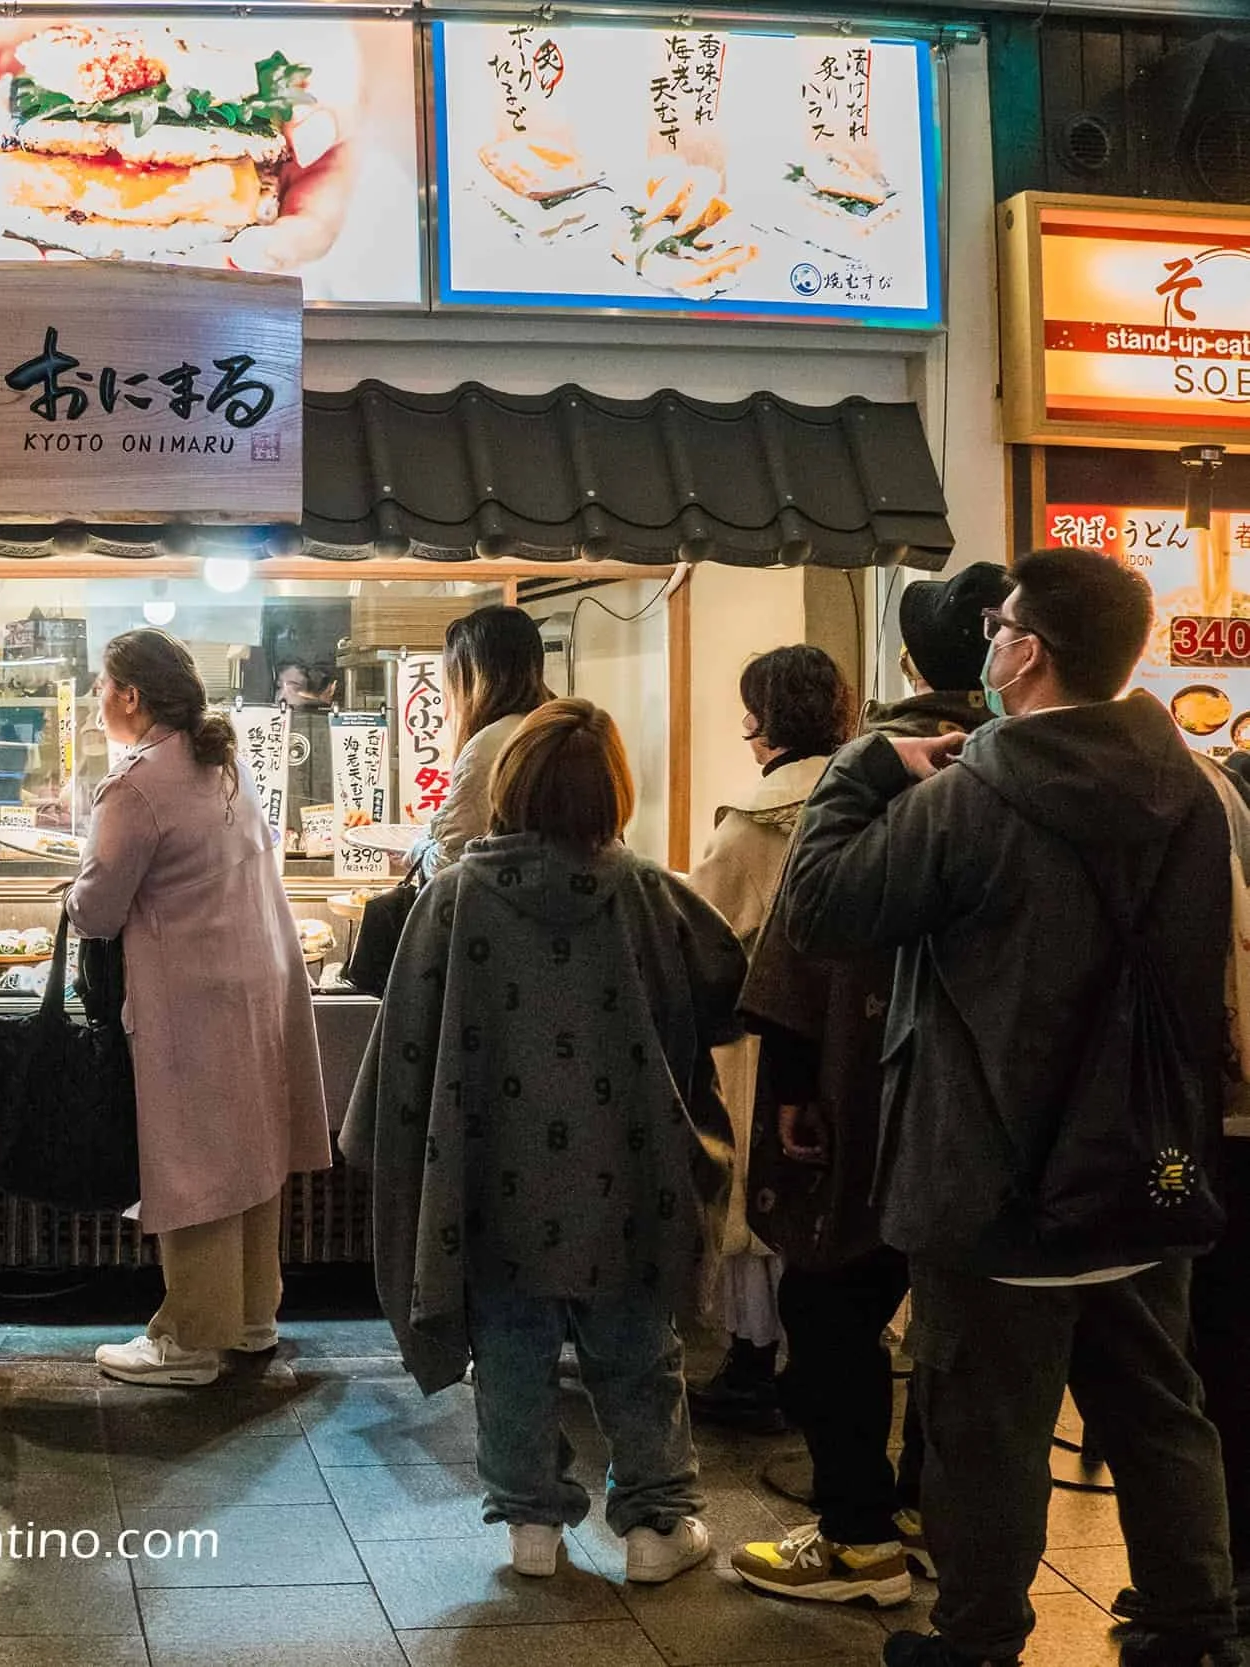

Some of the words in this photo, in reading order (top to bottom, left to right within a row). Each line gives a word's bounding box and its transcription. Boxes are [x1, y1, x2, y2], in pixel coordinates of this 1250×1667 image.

[695, 34, 720, 125] 香味だれ
[815, 56, 845, 109] 炙り
[847, 49, 869, 142] 漬けだれ
[651, 77, 680, 150] 天むす
[802, 83, 834, 141] ハラス
[5, 326, 274, 429] おにまる
[24, 432, 103, 452] KYOTO
[122, 432, 234, 454] ONIMARU
[1125, 554, 1153, 567] DON
[1173, 618, 1250, 659] 340
